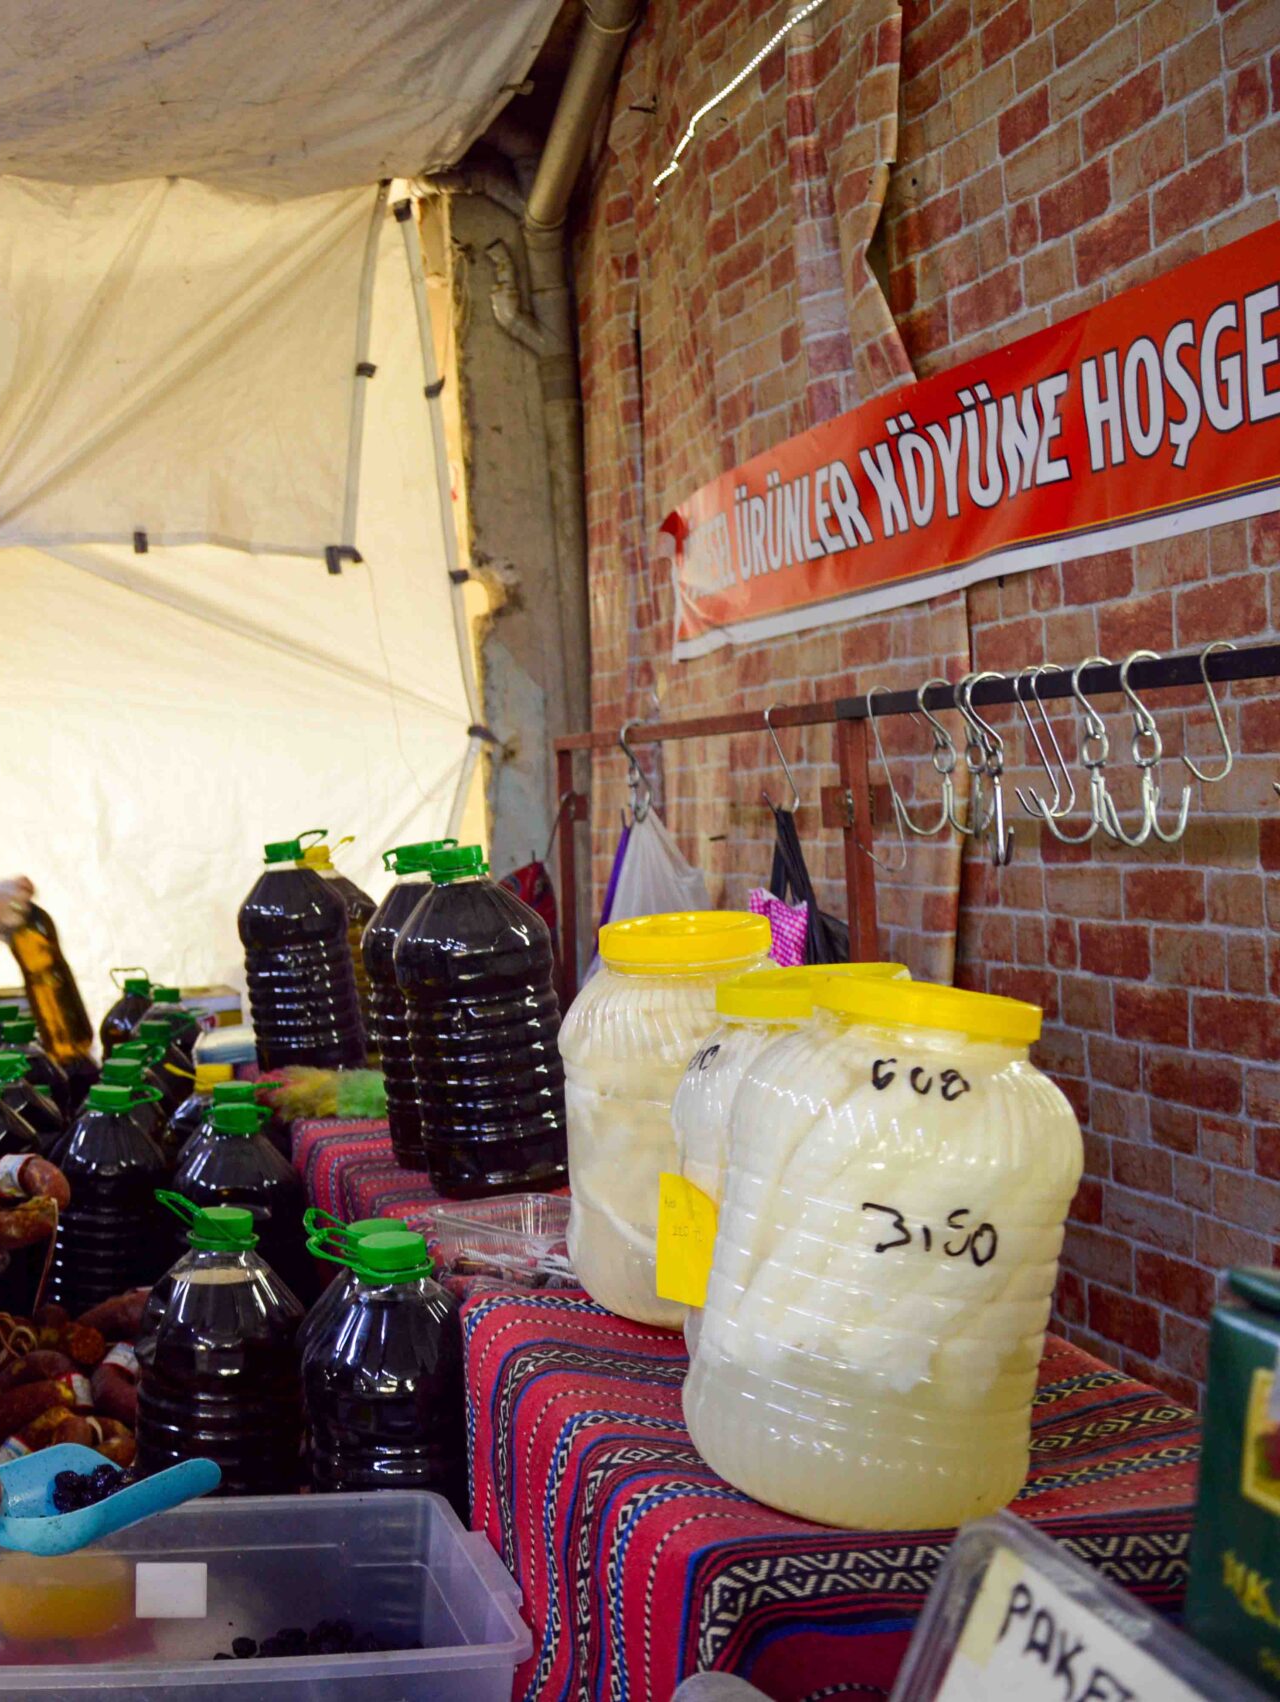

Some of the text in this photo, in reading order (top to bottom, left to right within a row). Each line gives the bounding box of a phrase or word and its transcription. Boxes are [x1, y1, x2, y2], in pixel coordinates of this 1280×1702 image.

[734, 459, 873, 580] ÜRÜNLER
[858, 380, 1071, 538] KÖYÜNE
[1081, 282, 1280, 473] HOŞGE
